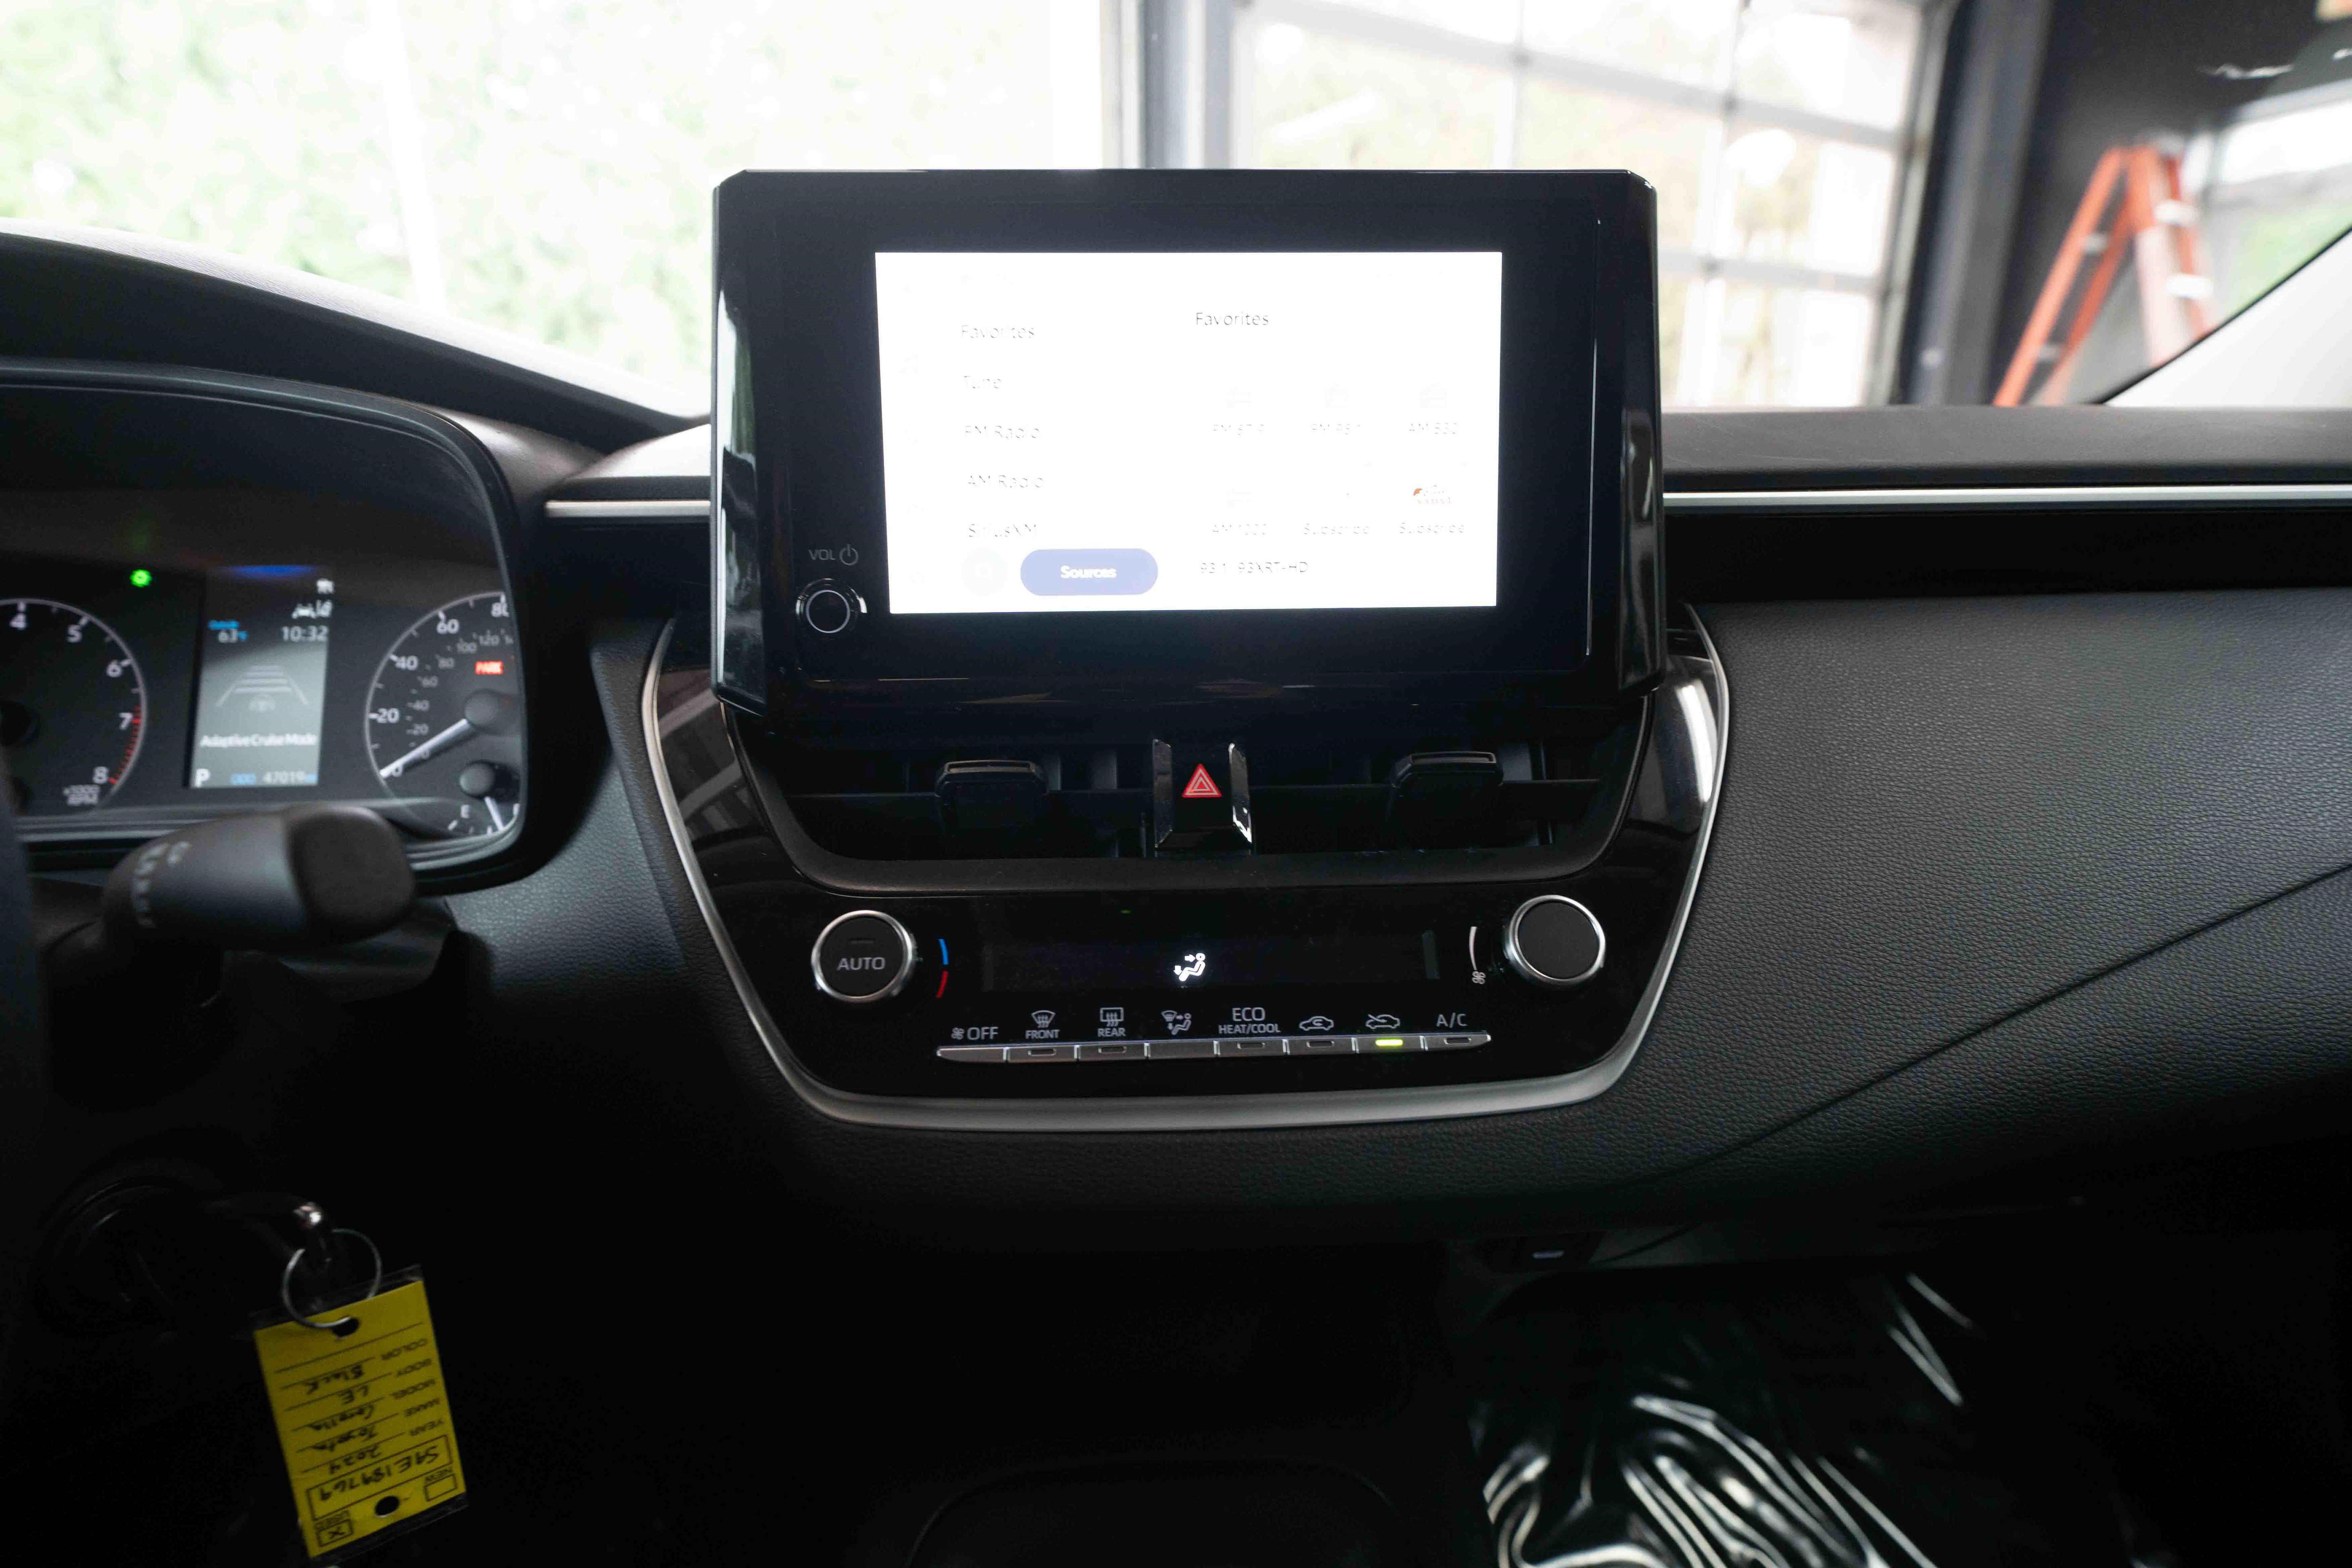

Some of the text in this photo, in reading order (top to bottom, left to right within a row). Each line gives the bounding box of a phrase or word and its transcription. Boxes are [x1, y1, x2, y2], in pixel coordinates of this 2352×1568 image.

[1195, 312, 1270, 326] Favorites
[960, 324, 1036, 339] Favorites
[962, 376, 1003, 390] Tune
[808, 549, 836, 561] VOL
[1060, 565, 1117, 579] Sources
[10, 613, 27, 630] 4
[437, 618, 460, 635] 60
[67, 624, 82, 643] 5
[282, 625, 329, 643] 10:32
[106, 659, 122, 678] 6
[396, 655, 419, 670] 40
[421, 675, 439, 688] 60
[118, 712, 133, 730] 7
[376, 707, 400, 724] 20
[413, 723, 429, 736] 20
[93, 766, 109, 784] 8
[194, 768, 211, 787] P
[837, 956, 886, 971] AUTO
[1232, 1007, 1266, 1022] ECO
[1436, 1012, 1469, 1028] A/C
[966, 1026, 999, 1040] OFF
[1025, 1029, 1060, 1040] FRONT
[1097, 1027, 1126, 1038] REAR
[1218, 1023, 1281, 1035] HEAT/COOL
[394, 1379, 436, 1400] MODEL
[403, 1396, 441, 1419] MAKE
[407, 1418, 445, 1438] YEAR
[326, 1443, 383, 1476] 2024
